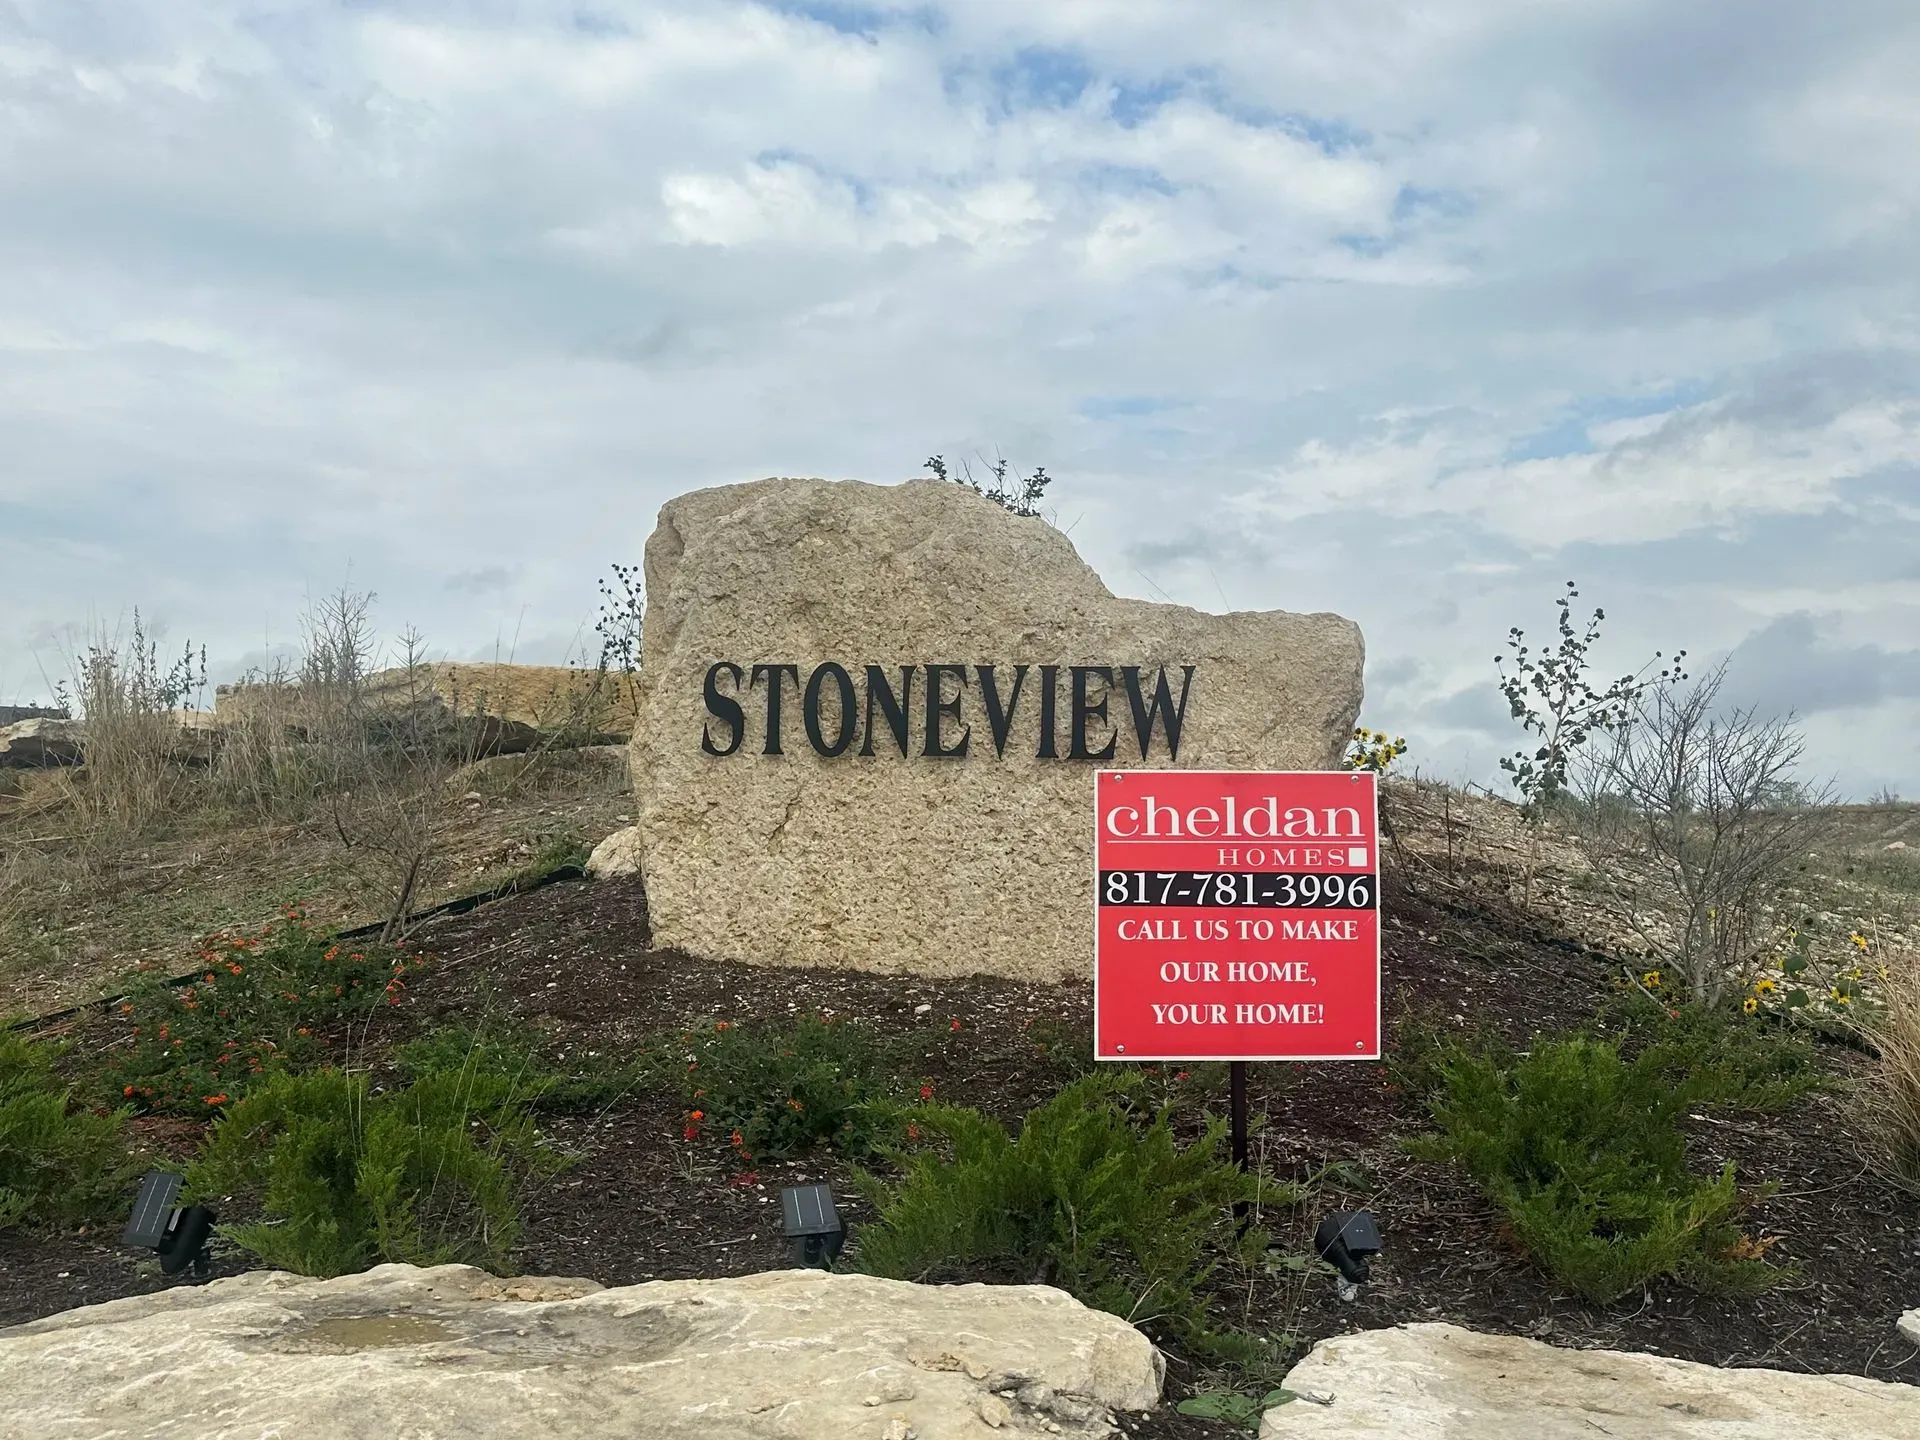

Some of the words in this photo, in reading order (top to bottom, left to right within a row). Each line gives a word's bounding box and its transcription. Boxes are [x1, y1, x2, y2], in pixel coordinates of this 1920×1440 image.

[701, 661, 1196, 761] STONEVIEW
[1106, 796, 1366, 838] cheldan
[1217, 848, 1345, 867] HOMES
[1106, 872, 1369, 908] 817-781-3996
[1118, 920, 1187, 941] CALL
[1194, 920, 1229, 941] US
[1235, 920, 1274, 941] TO
[1281, 920, 1359, 941] MAKE
[1160, 962, 1221, 983] OUR
[1227, 962, 1317, 987] HOME,
[1151, 1003, 1228, 1024] YOUR
[1235, 1003, 1324, 1024] HOME!
